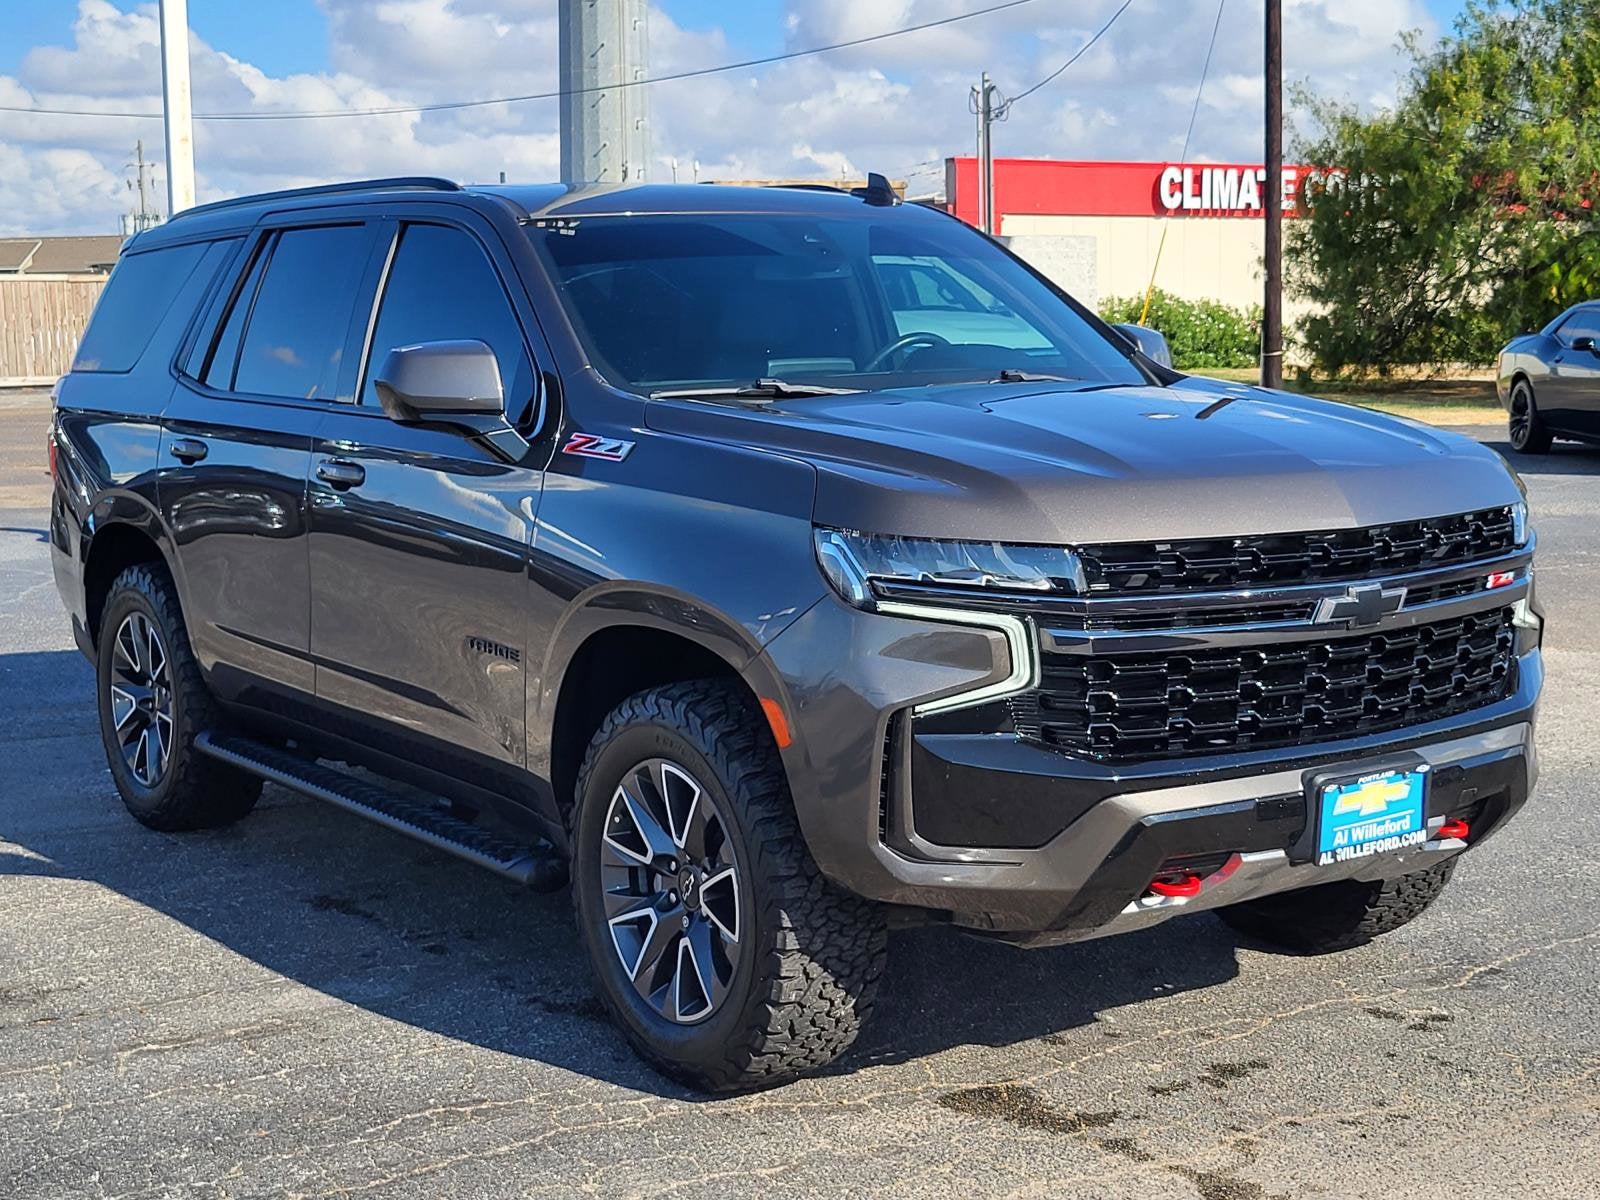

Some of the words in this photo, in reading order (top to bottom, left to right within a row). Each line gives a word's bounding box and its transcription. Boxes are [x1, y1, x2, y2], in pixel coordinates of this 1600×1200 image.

[562, 432, 636, 462] Z71
[1357, 770, 1396, 785] PORTLAND
[1332, 831, 1349, 847] Al
[1351, 815, 1411, 843] Willeford
[1318, 852, 1335, 866] AL
[1335, 829, 1427, 862] WILLEFORD.COM
